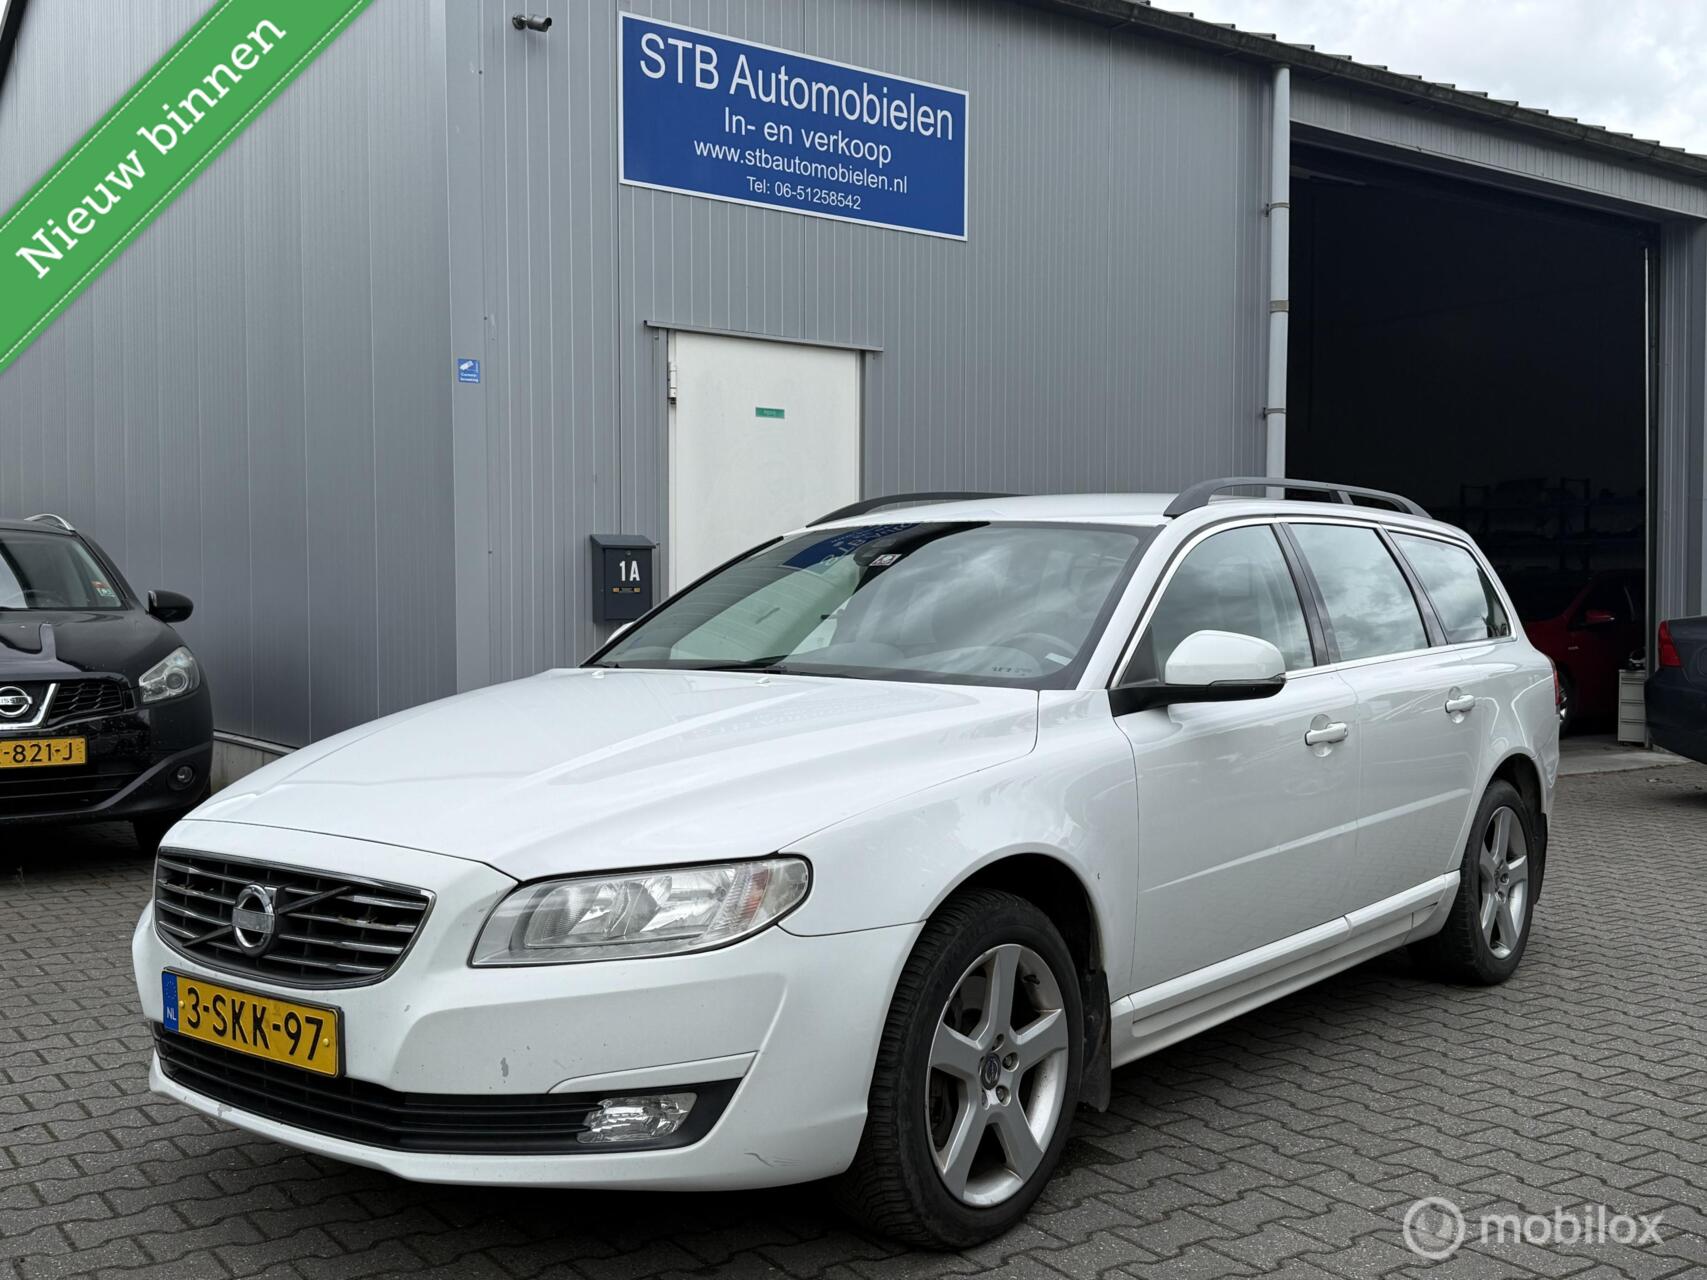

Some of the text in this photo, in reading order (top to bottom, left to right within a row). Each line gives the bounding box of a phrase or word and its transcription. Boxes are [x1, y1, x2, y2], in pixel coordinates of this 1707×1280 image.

[640, 32, 954, 140] STB Automobielen
[724, 107, 892, 168] In- en verkoop
[693, 139, 908, 194] www.stbautomobielen.nl
[746, 176, 862, 210] Tel: 06-51258542
[619, 560, 641, 582] 1A
[166, 1007, 177, 1022] NL
[187, 986, 324, 1061] 3-SKK-97
